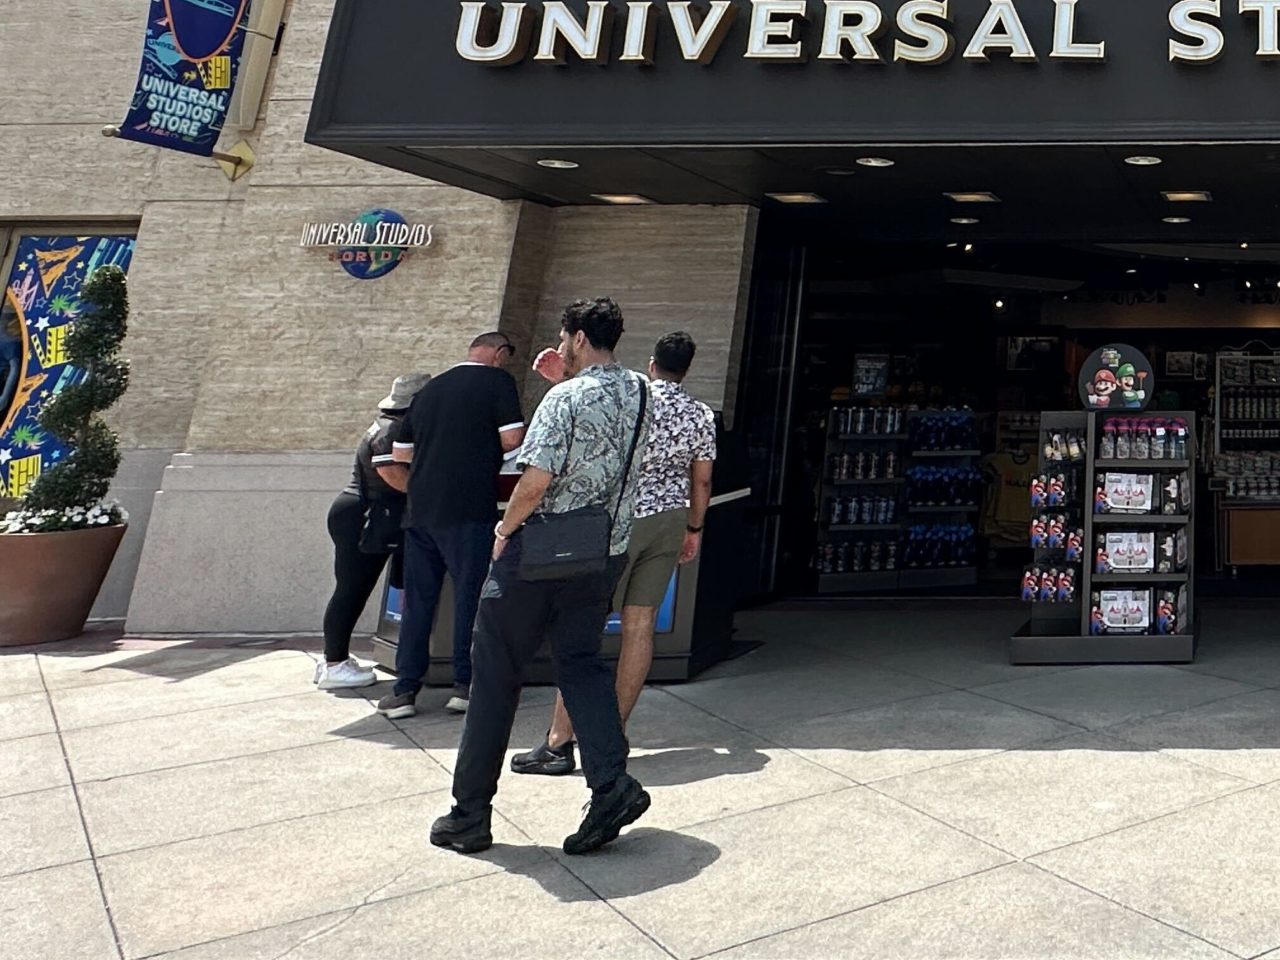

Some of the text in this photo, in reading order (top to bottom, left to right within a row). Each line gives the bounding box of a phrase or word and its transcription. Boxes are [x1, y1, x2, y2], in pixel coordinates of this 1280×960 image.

[141, 74, 227, 111] UNIVERSAL
[146, 95, 214, 122] STUDIOS
[149, 112, 203, 137] STORE
[300, 221, 433, 246] UNIVERSAL STUDIOS
[328, 250, 408, 263] ORIDA
